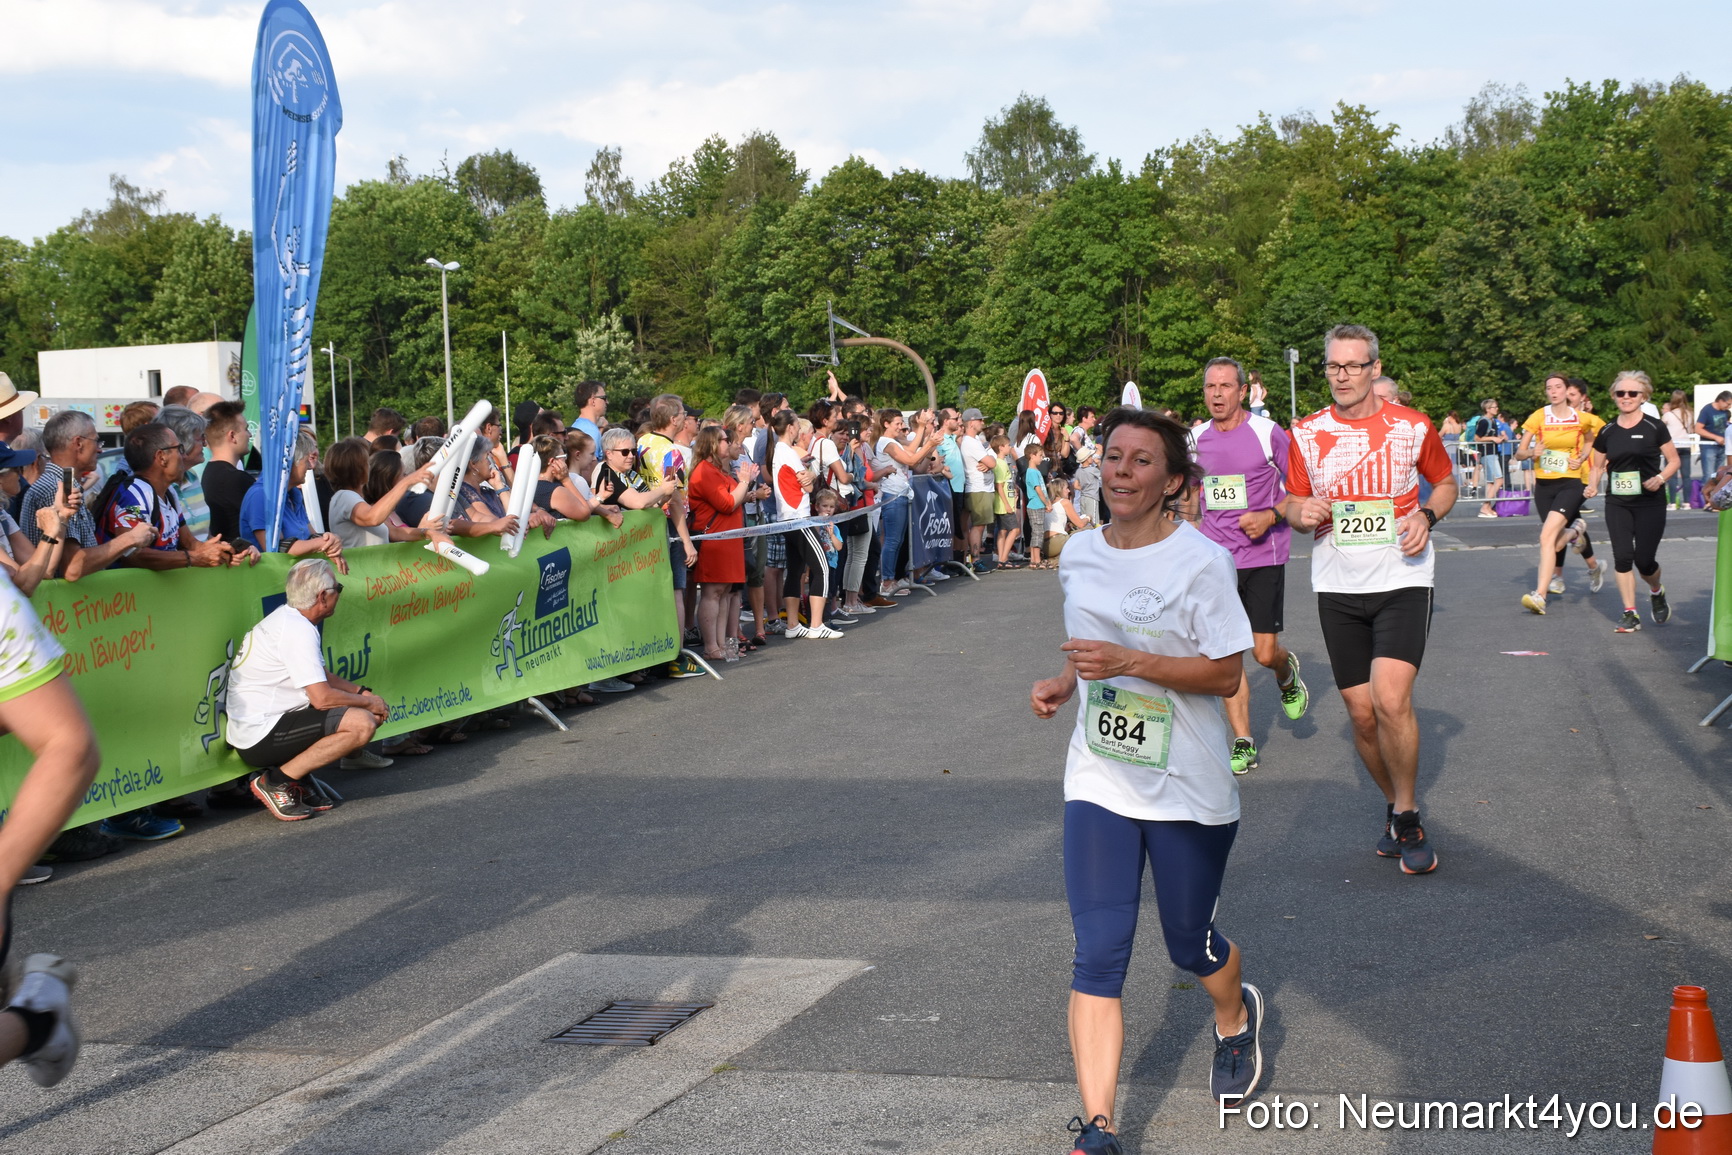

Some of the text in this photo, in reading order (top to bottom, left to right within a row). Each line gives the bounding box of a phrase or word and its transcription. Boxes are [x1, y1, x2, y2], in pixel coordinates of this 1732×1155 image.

[1543, 456, 1565, 467] 1649
[1213, 487, 1236, 500] 643
[1615, 480, 1633, 489] 953
[1340, 516, 1387, 533] 2202
[366, 561, 418, 601] Gesunde
[545, 569, 567, 586] Fischer
[72, 592, 137, 629] Firmen
[390, 571, 477, 627] laufen länger!
[521, 588, 598, 656] firmenlauf
[90, 614, 155, 671] länger!
[525, 646, 563, 671] neumarkt
[1098, 711, 1146, 745] 684
[1117, 742, 1139, 753] Peggy
